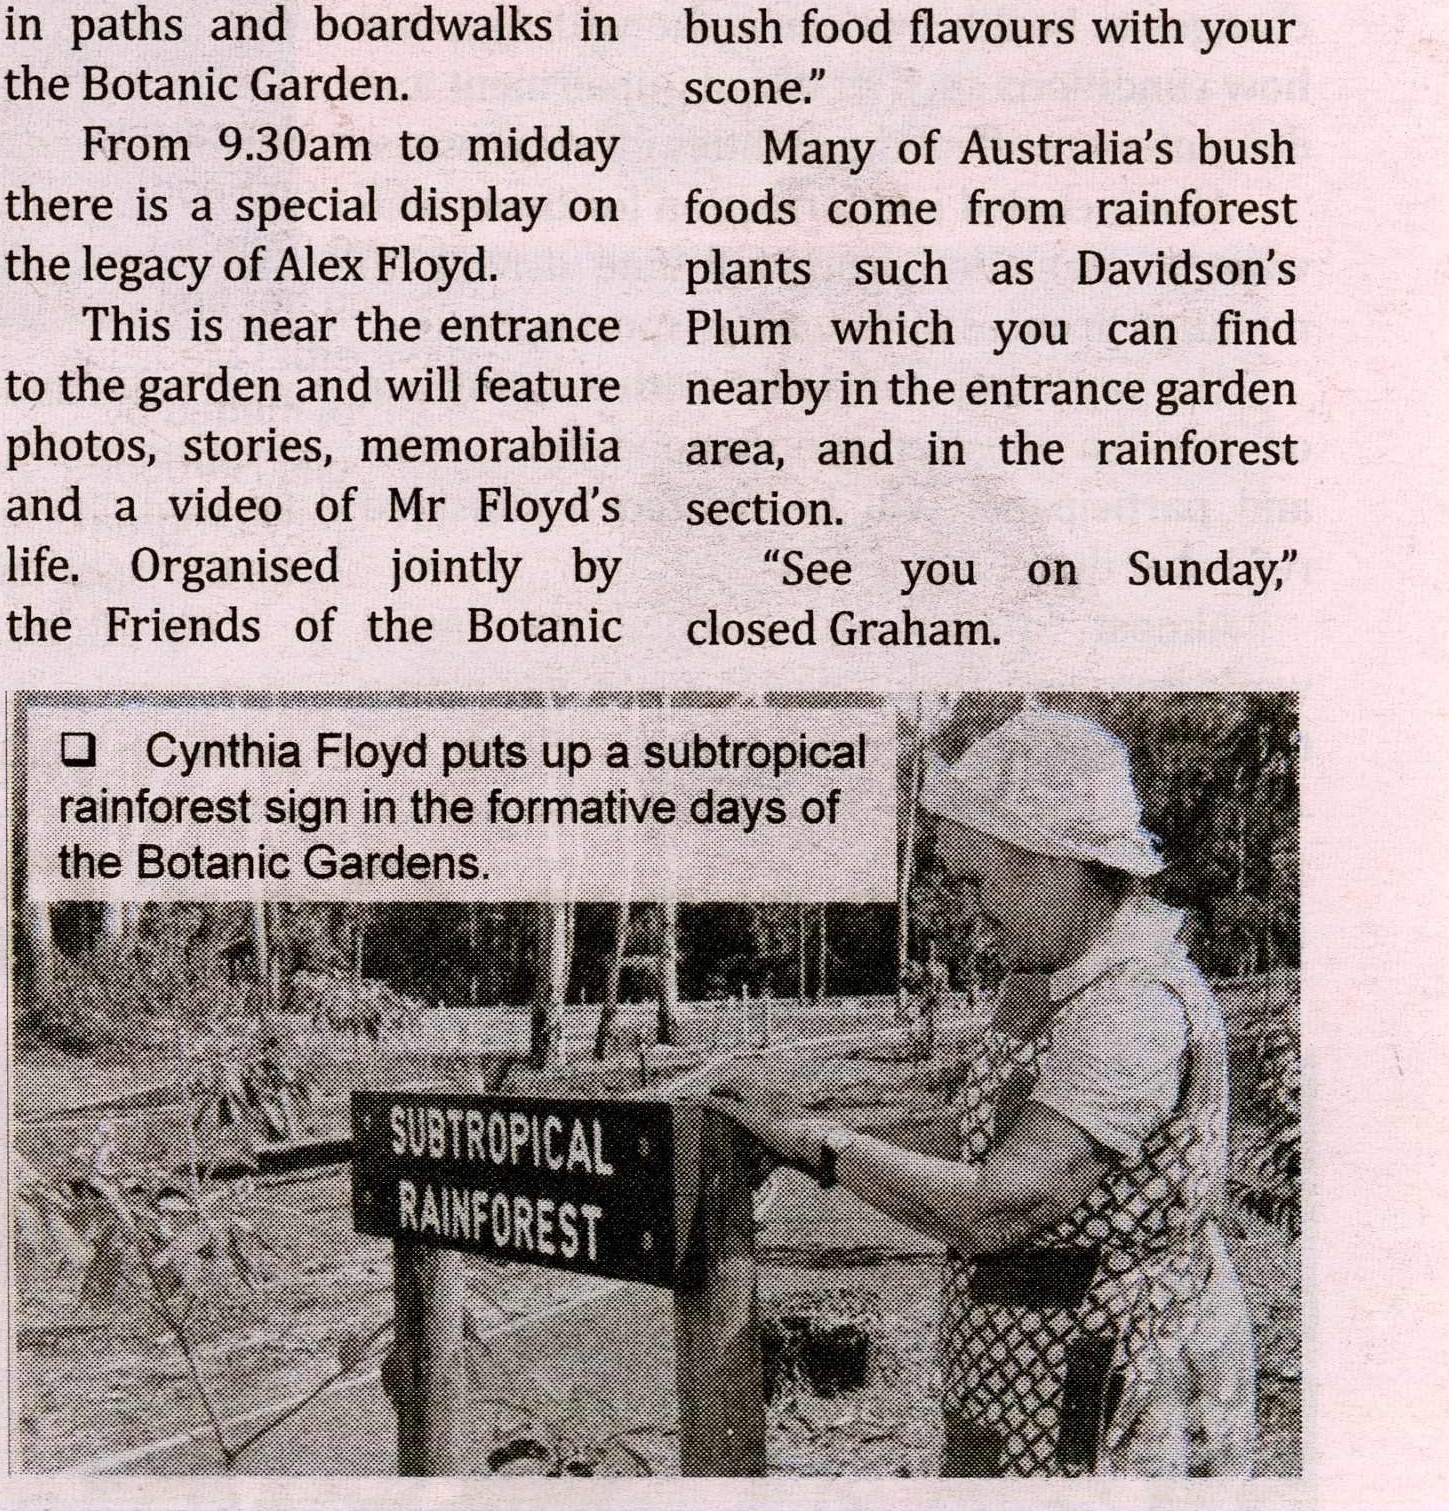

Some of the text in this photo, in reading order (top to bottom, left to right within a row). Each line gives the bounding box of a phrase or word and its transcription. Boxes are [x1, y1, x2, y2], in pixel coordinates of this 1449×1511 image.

[83, 125, 621, 173] From 9.30am to midday
[686, 248, 1296, 295] plants such as Davidson’s
[7, 424, 620, 472] photos, stories, memorabilia
[146, 731, 866, 779] Cynthia Floyd puts up a subtropical
[60, 787, 842, 834] rainforest sign in the formative days of
[57, 843, 489, 881] the Botanic Gardens.
[389, 1103, 614, 1177] SUBTROPICAL
[398, 1180, 603, 1263] RAINFOREST
